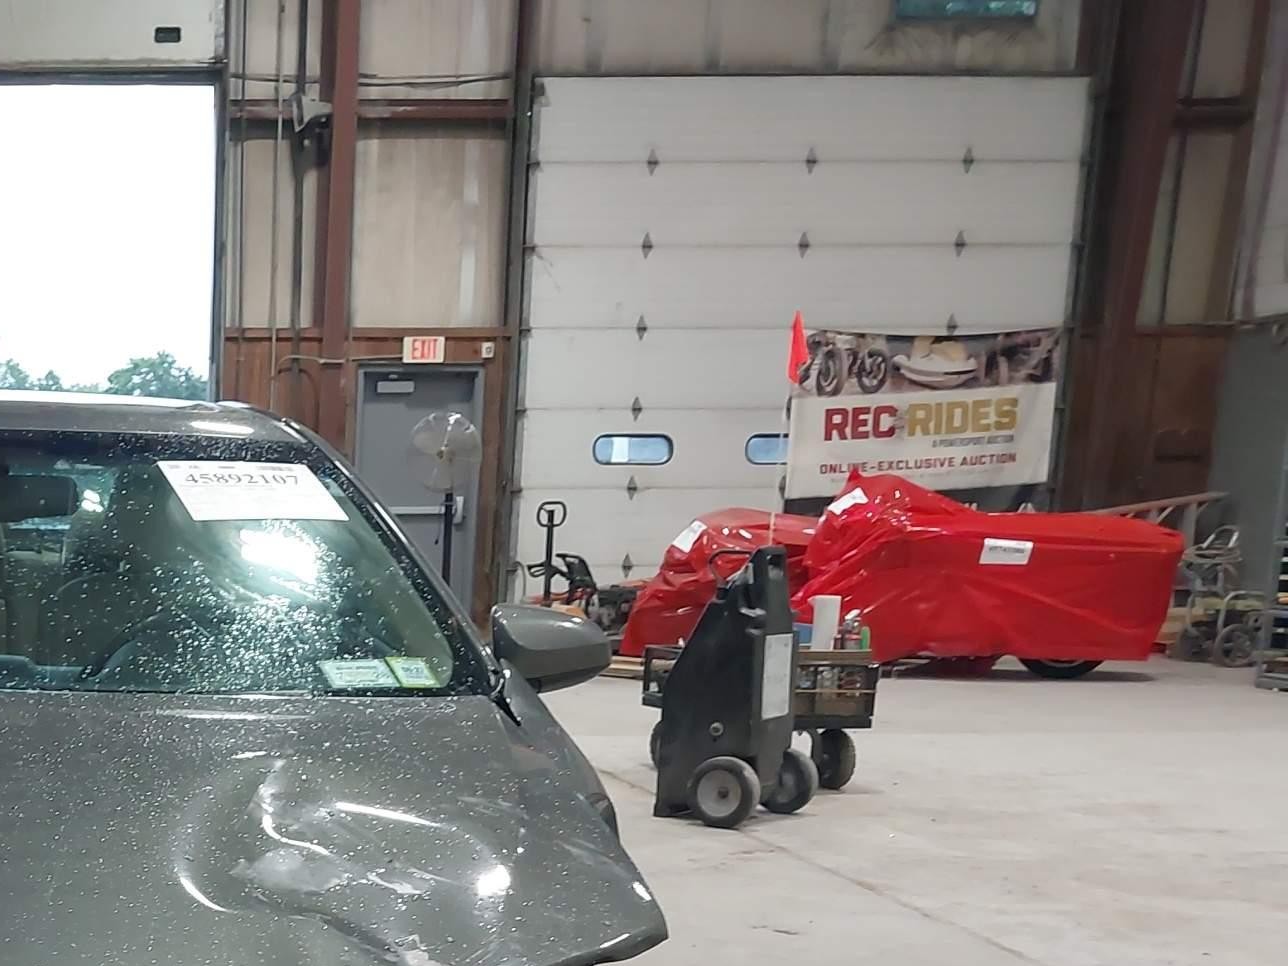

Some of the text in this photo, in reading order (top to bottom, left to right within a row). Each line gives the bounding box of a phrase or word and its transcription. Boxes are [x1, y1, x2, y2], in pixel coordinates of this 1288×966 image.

[412, 338, 438, 360] EXIT
[824, 398, 1018, 441] REC RIDES
[820, 452, 1017, 474] ONLINE-EXCLUSIVE AUCTION
[184, 472, 299, 486] 45892107
